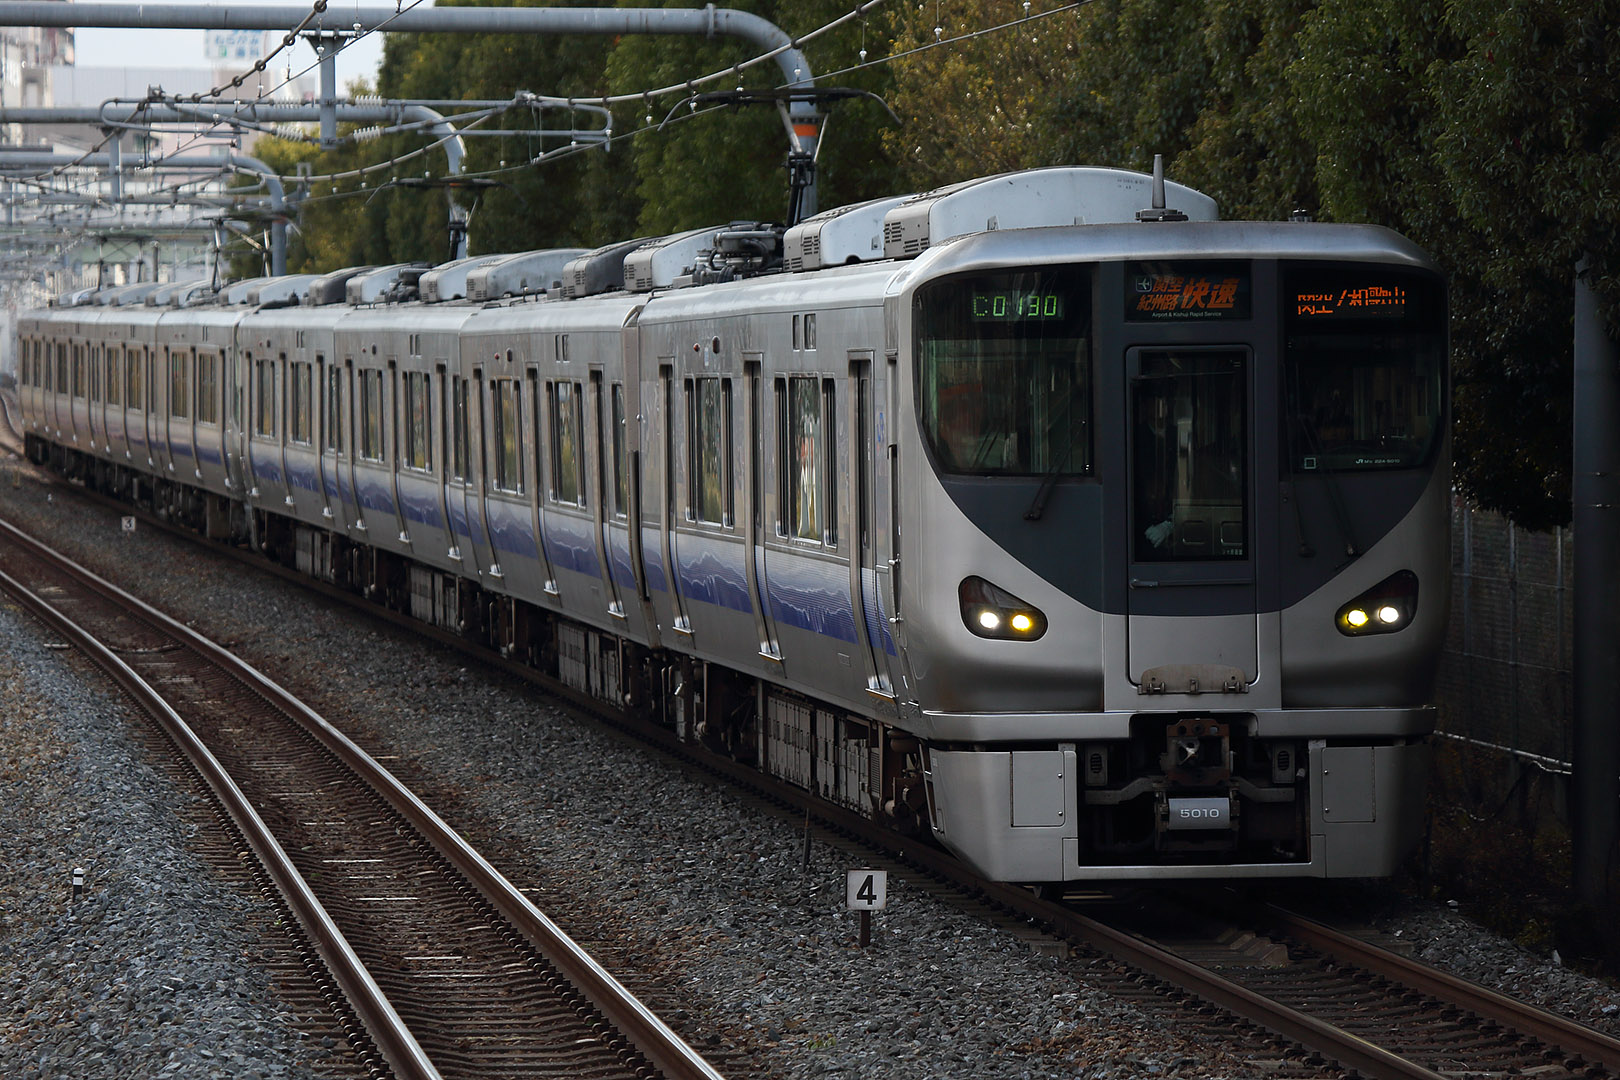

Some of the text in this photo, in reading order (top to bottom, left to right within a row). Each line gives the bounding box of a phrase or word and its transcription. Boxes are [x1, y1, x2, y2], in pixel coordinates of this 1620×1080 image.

[1136, 294, 1180, 311] 紀州路
[1181, 277, 1240, 309] 快速
[1180, 809, 1220, 818] 5010
[856, 874, 877, 905] 4
